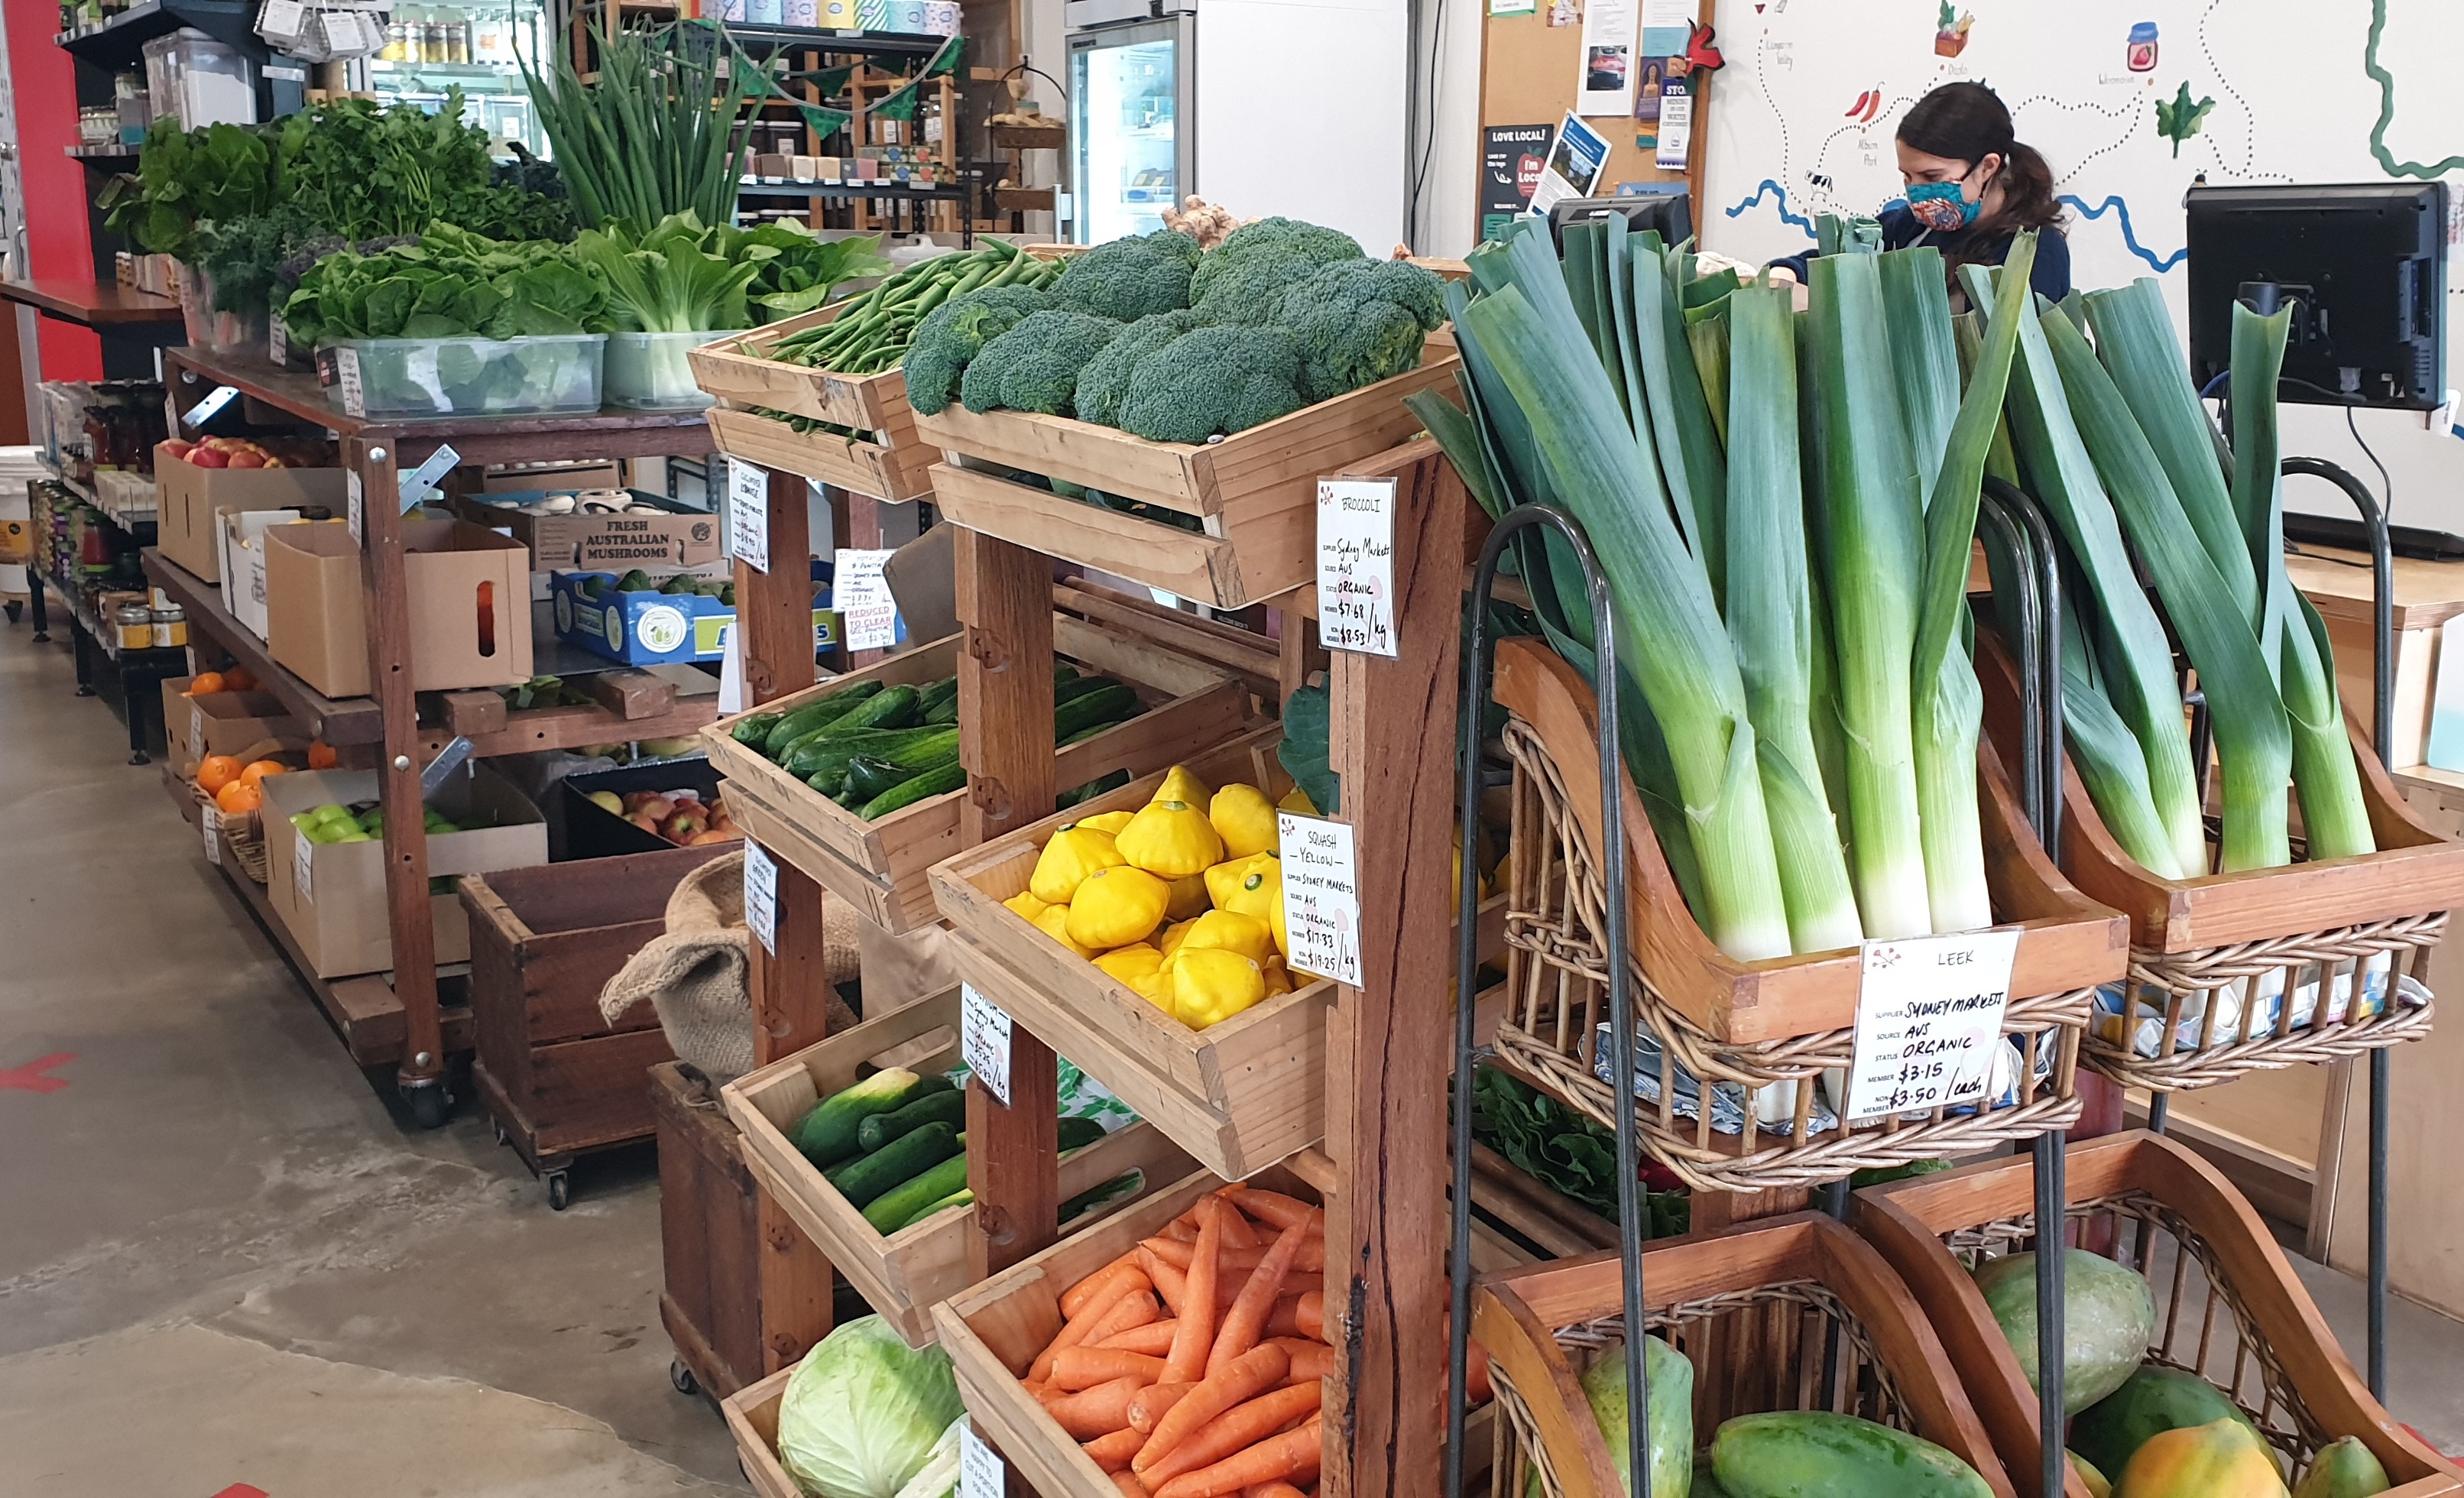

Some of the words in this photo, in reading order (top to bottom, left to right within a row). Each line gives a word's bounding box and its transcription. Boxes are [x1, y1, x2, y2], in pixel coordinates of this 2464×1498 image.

[1666, 85, 1687, 96] STO
[1493, 131, 1515, 142] LOVE
[1516, 128, 1546, 141] LOCAL!
[1342, 498, 1380, 513] BROCCOLI
[607, 521, 648, 531] FRESH
[586, 534, 669, 546] AUSTRALIAN
[587, 548, 667, 559] MUSHROOMS
[1337, 538, 1359, 562] Sydney
[1363, 537, 1389, 558] Markets
[1338, 563, 1353, 575] AUS
[1338, 583, 1373, 595] ORGANIC
[849, 606, 890, 618] REDUCED
[1338, 598, 1363, 619] $7.68
[864, 617, 891, 626] CLEAR
[1341, 623, 1365, 646] $8.53
[1308, 831, 1337, 849] SQUASH
[1300, 847, 1333, 867] YELLOW
[1302, 874, 1323, 888] SYDNEY
[1327, 879, 1353, 893] MARKETS
[1305, 894, 1316, 906] AUS
[1306, 913, 1335, 929] ORGANIC
[1307, 927, 1333, 948] $17.33
[1308, 948, 1335, 971] $19.25
[1938, 950, 1973, 965] LEEK
[1876, 1010, 1903, 1019] SUPPLIER
[1904, 998, 1952, 1018] SYDNEY
[1905, 1023, 1931, 1039] AUS
[1875, 1053, 1898, 1062] STATUS
[1902, 1037, 1972, 1059] ORGANIC
[1867, 1075, 1894, 1083] MEMBER
[1898, 1062, 1943, 1084] $3.15
[1889, 1087, 1936, 1110] $3.50
[1863, 1105, 1889, 1114] MEMBER
